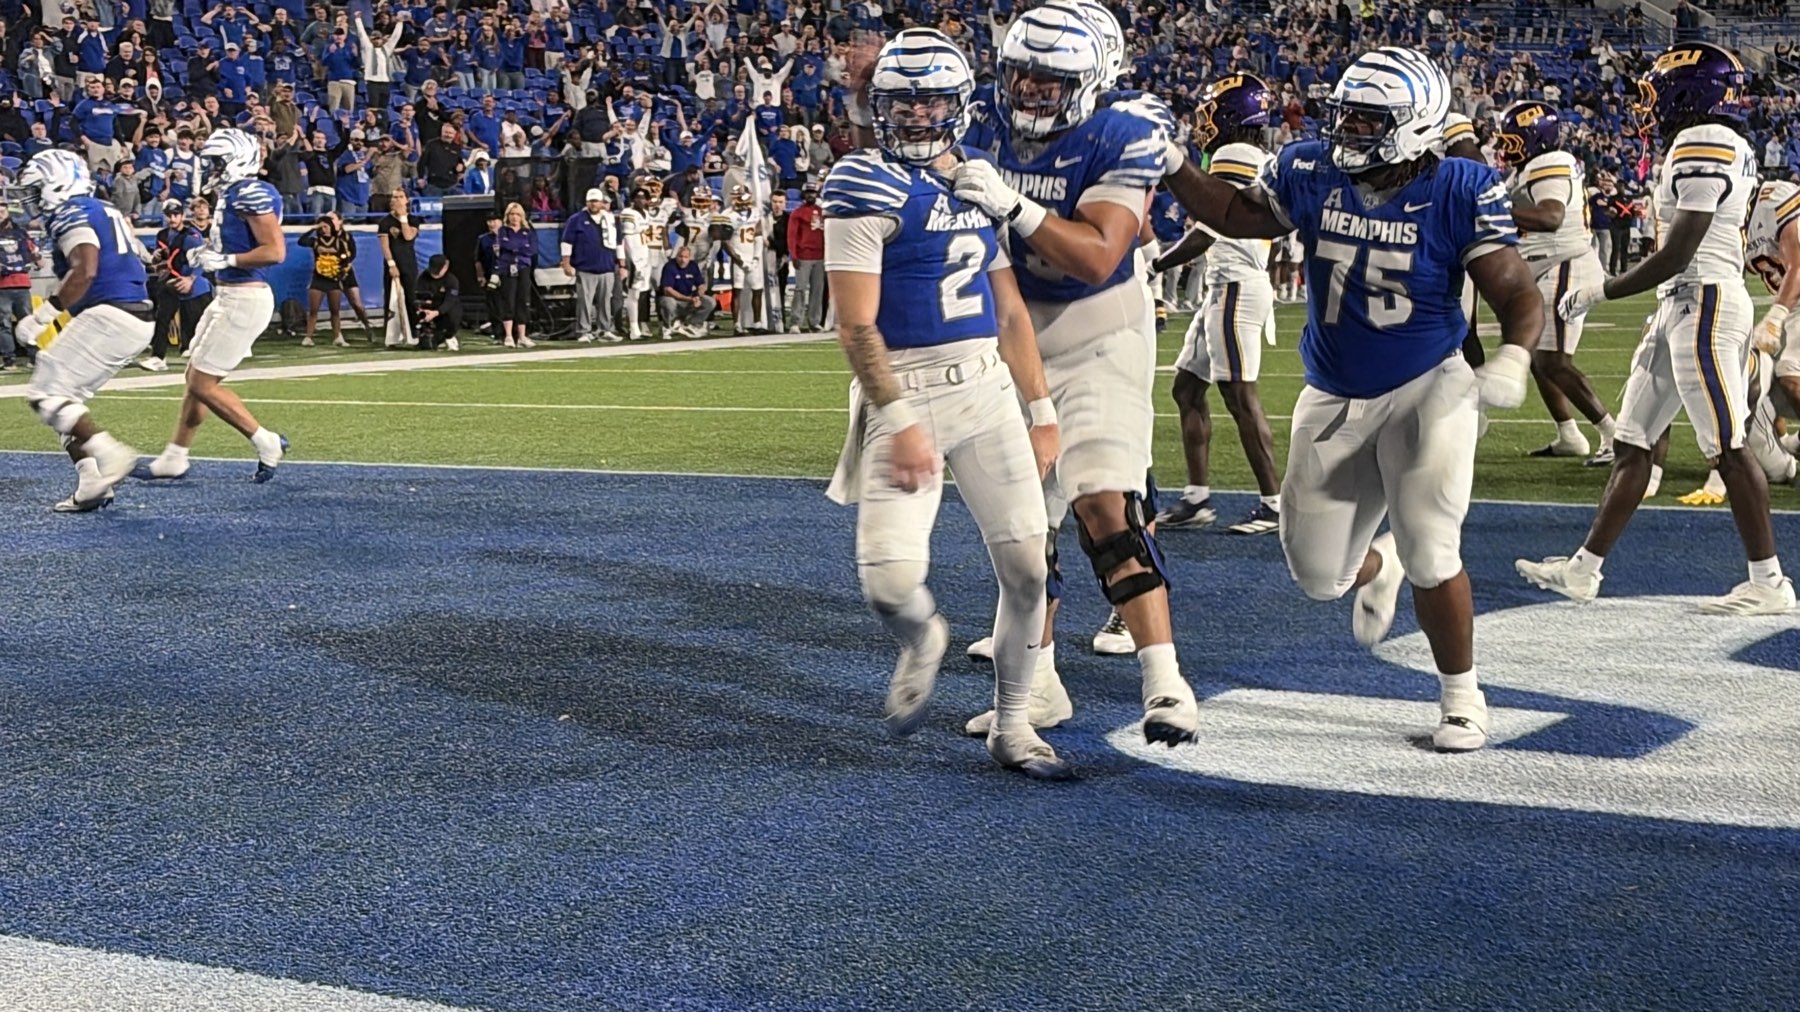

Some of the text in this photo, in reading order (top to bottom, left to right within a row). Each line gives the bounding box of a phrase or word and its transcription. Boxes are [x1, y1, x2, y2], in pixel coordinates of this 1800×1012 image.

[1655, 49, 1703, 76] ECU
[1000, 168, 1068, 201] MPHIS
[1320, 208, 1419, 245] MEMPHIS
[940, 233, 985, 321] 2
[1315, 239, 1414, 328] 75
